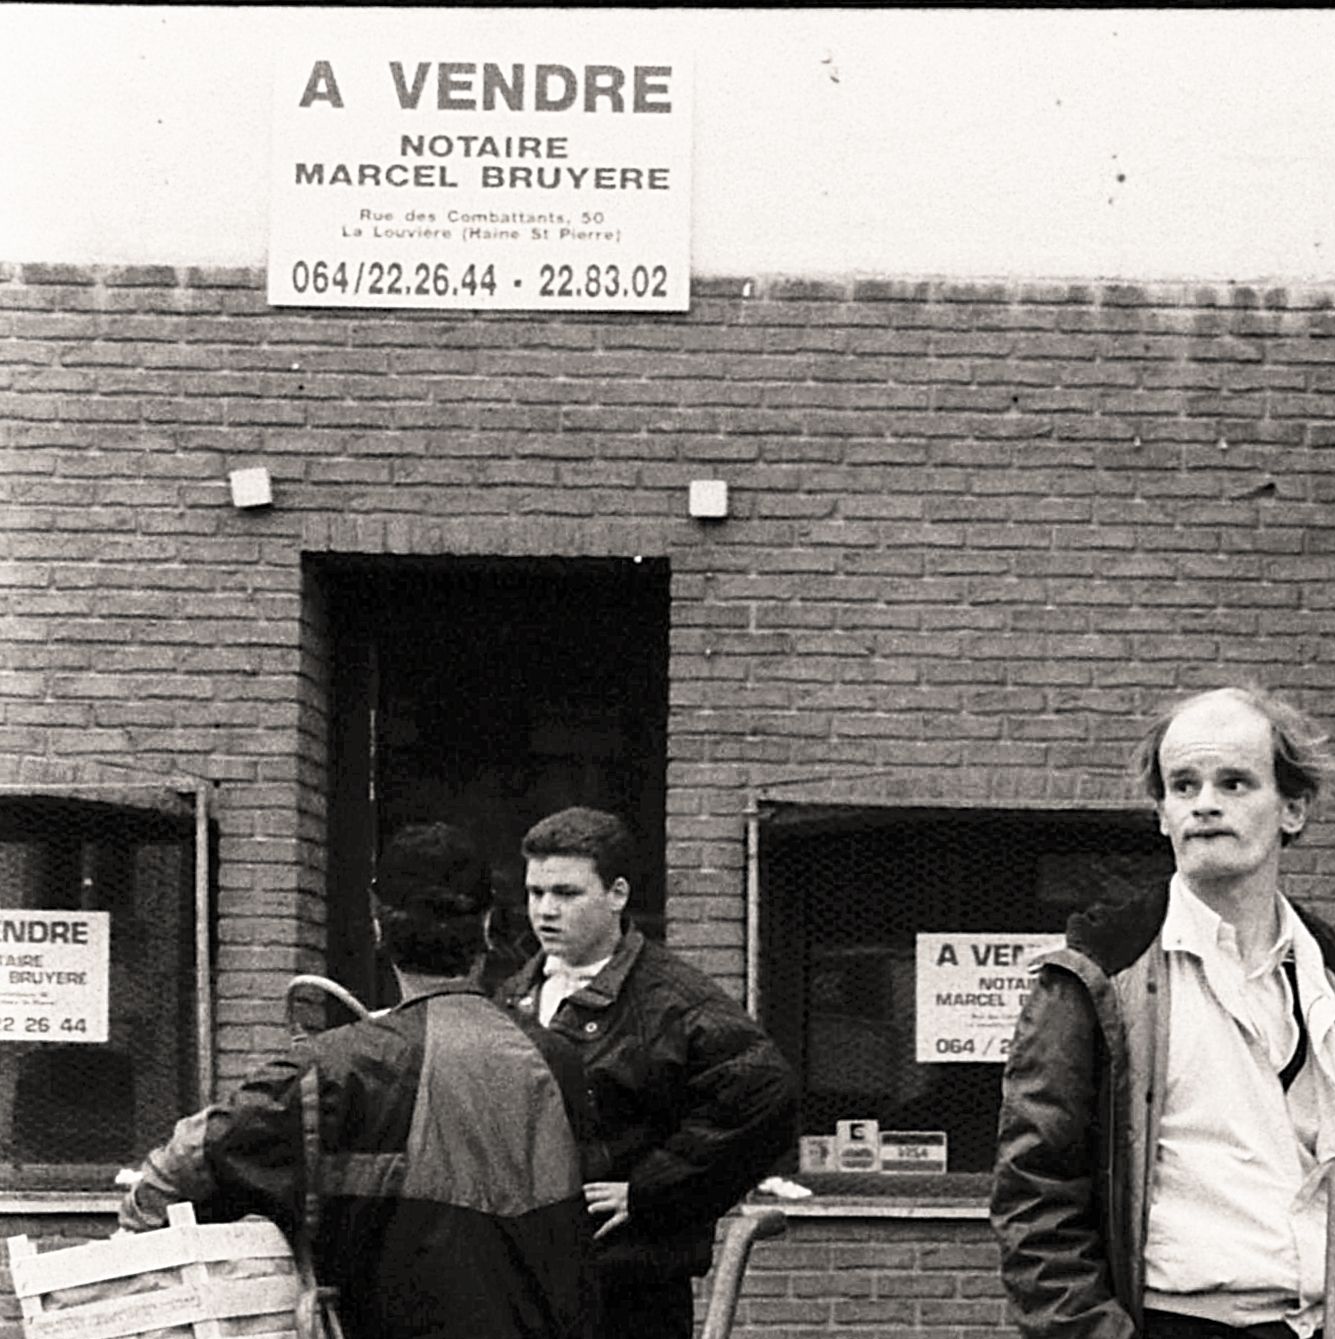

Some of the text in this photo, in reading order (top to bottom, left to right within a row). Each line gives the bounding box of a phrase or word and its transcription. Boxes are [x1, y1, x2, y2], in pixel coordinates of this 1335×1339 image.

[298, 60, 673, 114] A VENDRE
[400, 134, 569, 159] NOTAIRE
[294, 162, 671, 190] MARCEL BRUYERE
[359, 208, 394, 222] Rue
[404, 210, 437, 223] des
[580, 212, 605, 224] 50
[341, 226, 363, 238] La
[292, 260, 497, 297] 064/22.26.44
[538, 262, 668, 298] 22.83.02
[0, 919, 89, 945] NDRE
[935, 942, 959, 967] A
[935, 992, 1007, 1007] MARCEL
[24, 1016, 51, 1033] 26
[59, 1017, 87, 1034] 44
[935, 1038, 976, 1054] 064
